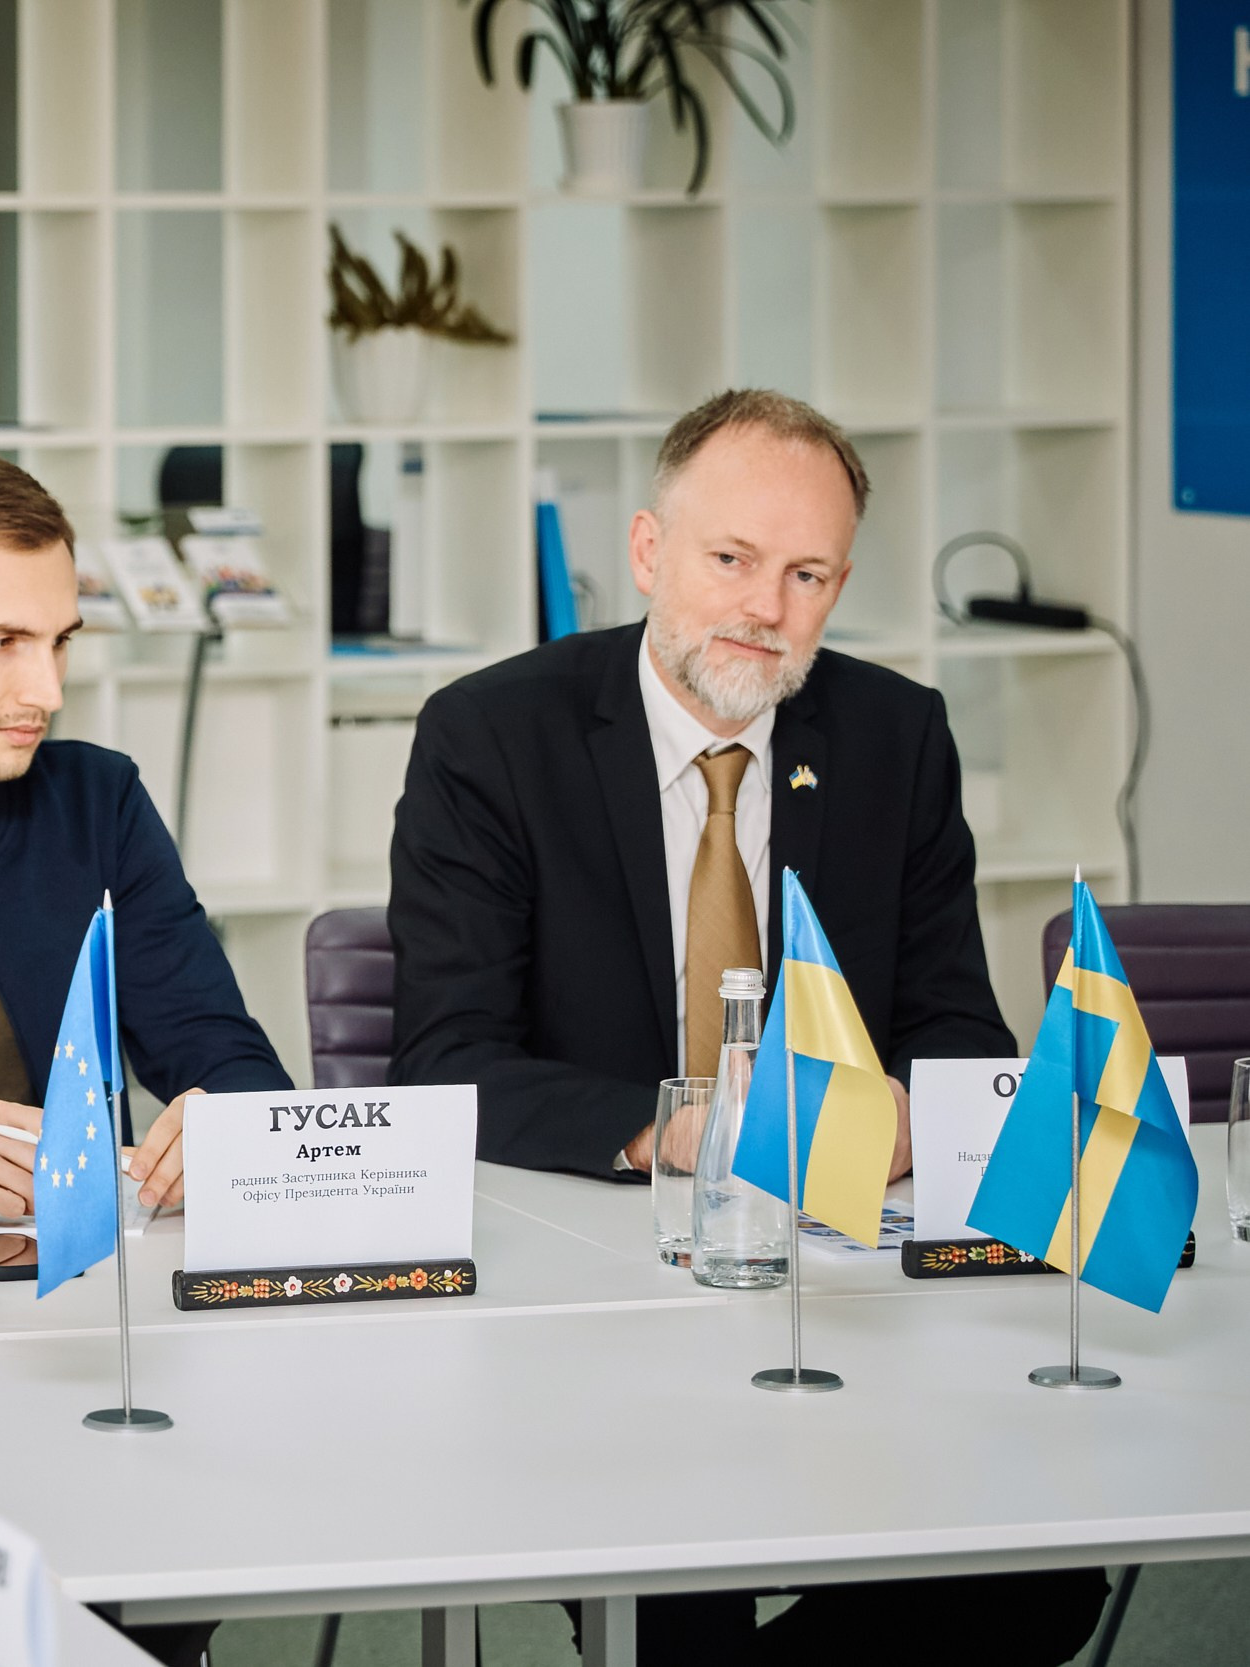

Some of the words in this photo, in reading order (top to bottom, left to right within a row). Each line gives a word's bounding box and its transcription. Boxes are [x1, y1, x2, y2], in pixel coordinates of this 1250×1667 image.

[269, 1101, 392, 1132] ГУСАК
[295, 1144, 362, 1162] Артем
[231, 1175, 278, 1188] радник
[281, 1171, 356, 1185] Заступника
[360, 1168, 427, 1181] Керівника
[242, 1190, 281, 1203] Офісу
[285, 1186, 358, 1201] Президента
[363, 1184, 415, 1197] України
